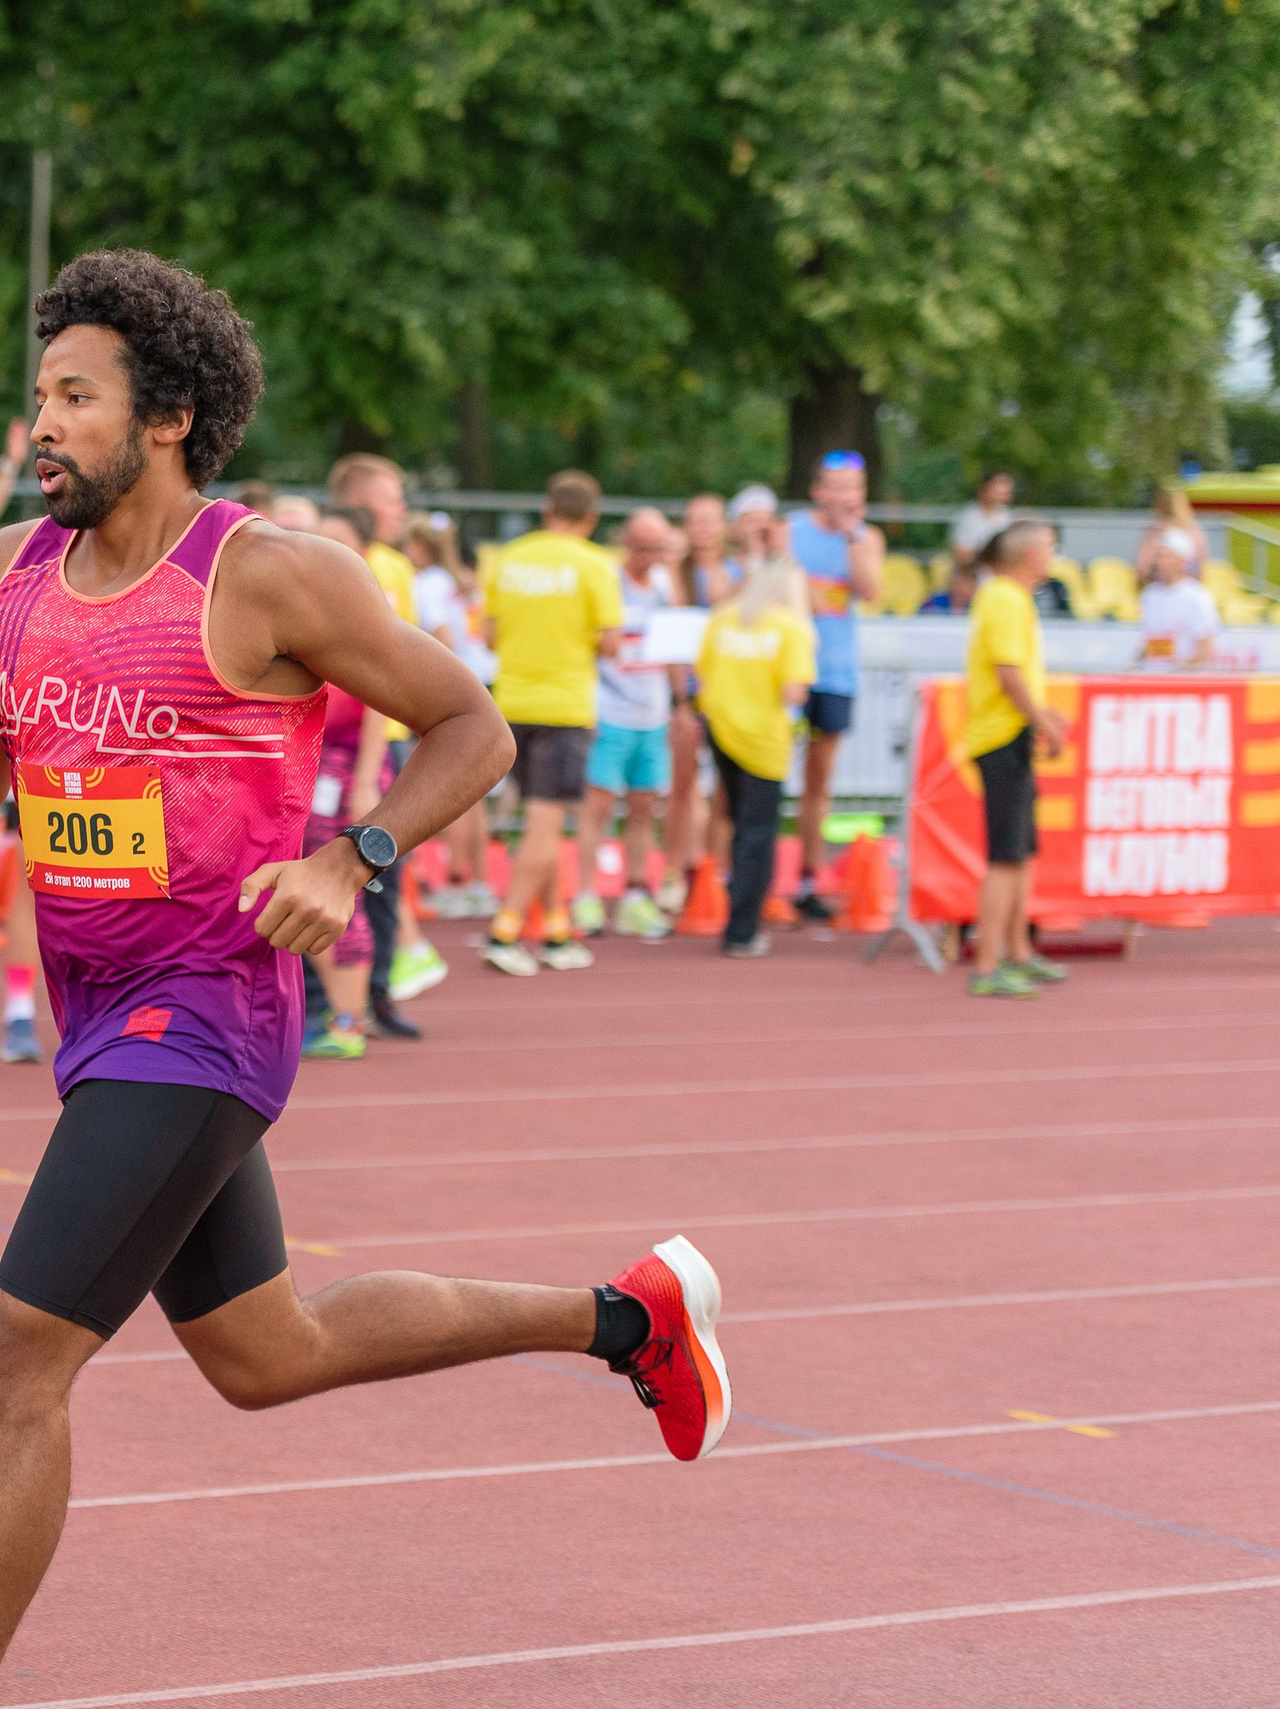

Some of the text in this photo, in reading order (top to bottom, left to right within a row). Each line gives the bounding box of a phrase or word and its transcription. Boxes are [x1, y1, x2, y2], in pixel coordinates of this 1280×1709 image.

[1089, 693, 1233, 774] БИТВА
[47, 811, 146, 856] 206 2
[72, 876, 92, 888] 1200
[93, 878, 131, 891] метров
[1083, 829, 1229, 897] КЛУБОВ
